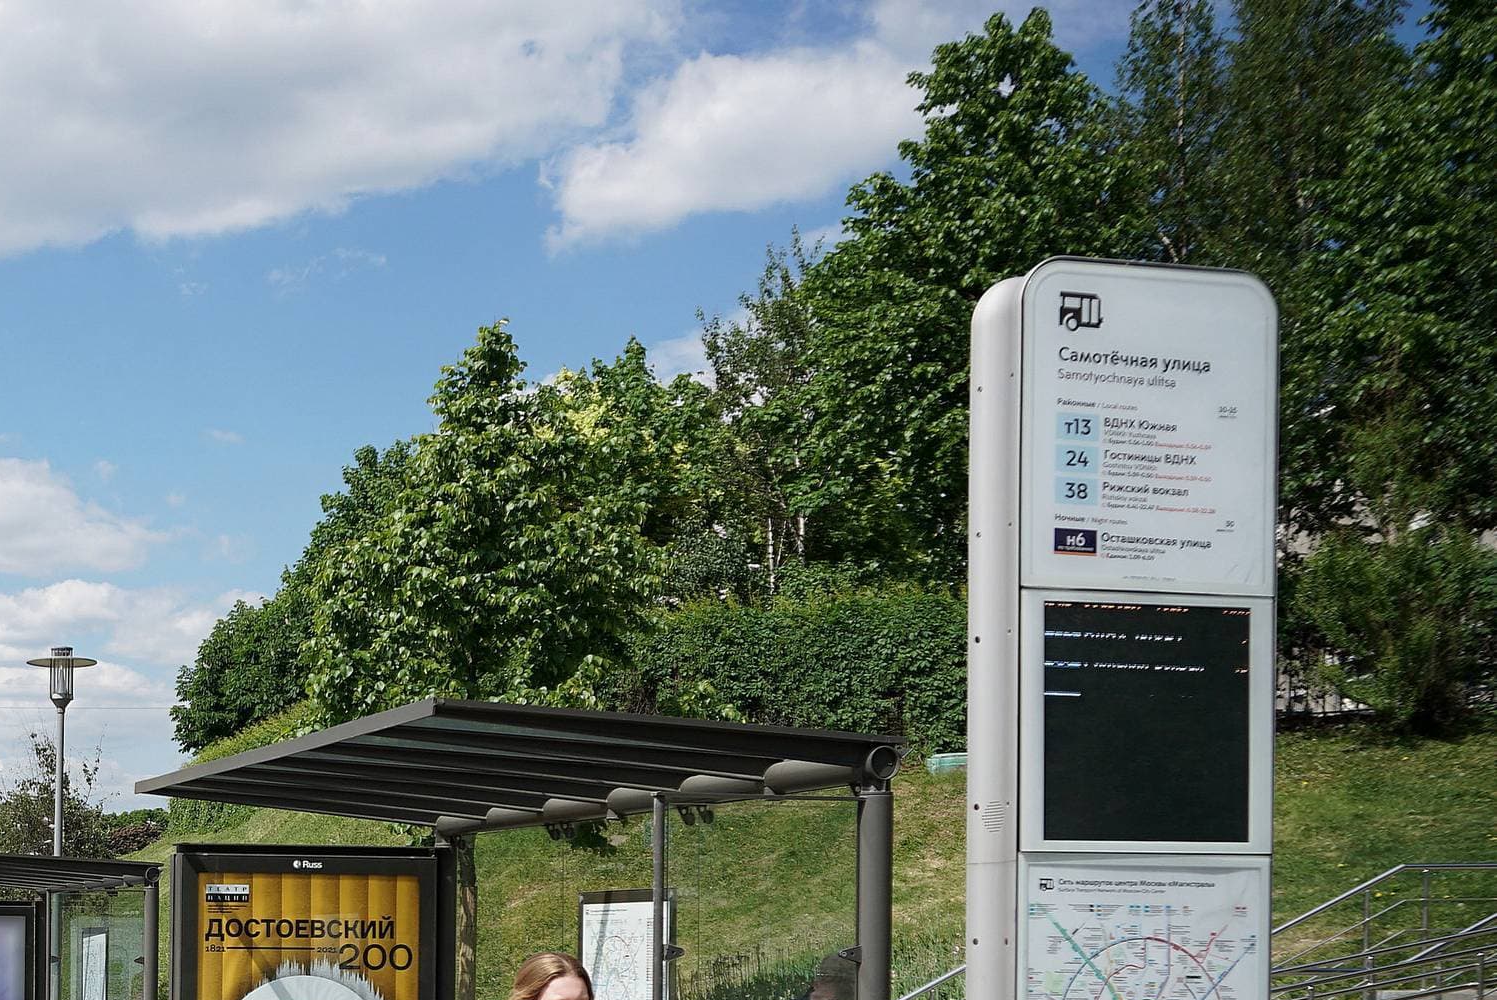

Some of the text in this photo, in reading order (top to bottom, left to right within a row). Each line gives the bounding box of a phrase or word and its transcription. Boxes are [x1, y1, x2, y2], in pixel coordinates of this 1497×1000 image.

[1058, 346, 1211, 374] Самотёчная улица
[1058, 368, 1176, 388] Samotyochnaya ulitsa
[1065, 418, 1091, 435] т13
[1104, 417, 1177, 432] ВДНХ Южная
[1066, 450, 1089, 467] 24
[1104, 449, 1197, 466] Гостиницы ВДНХ
[1065, 482, 1088, 499] 38
[1102, 481, 1189, 497] Рижский вокзал
[1066, 532, 1086, 546] н6
[1101, 532, 1212, 550] Осташковская улица
[302, 860, 323, 869] Russ
[205, 916, 395, 941] ДОСТОЕВСКИЙ
[205, 944, 225, 952] 1821
[339, 944, 413, 970] 200
